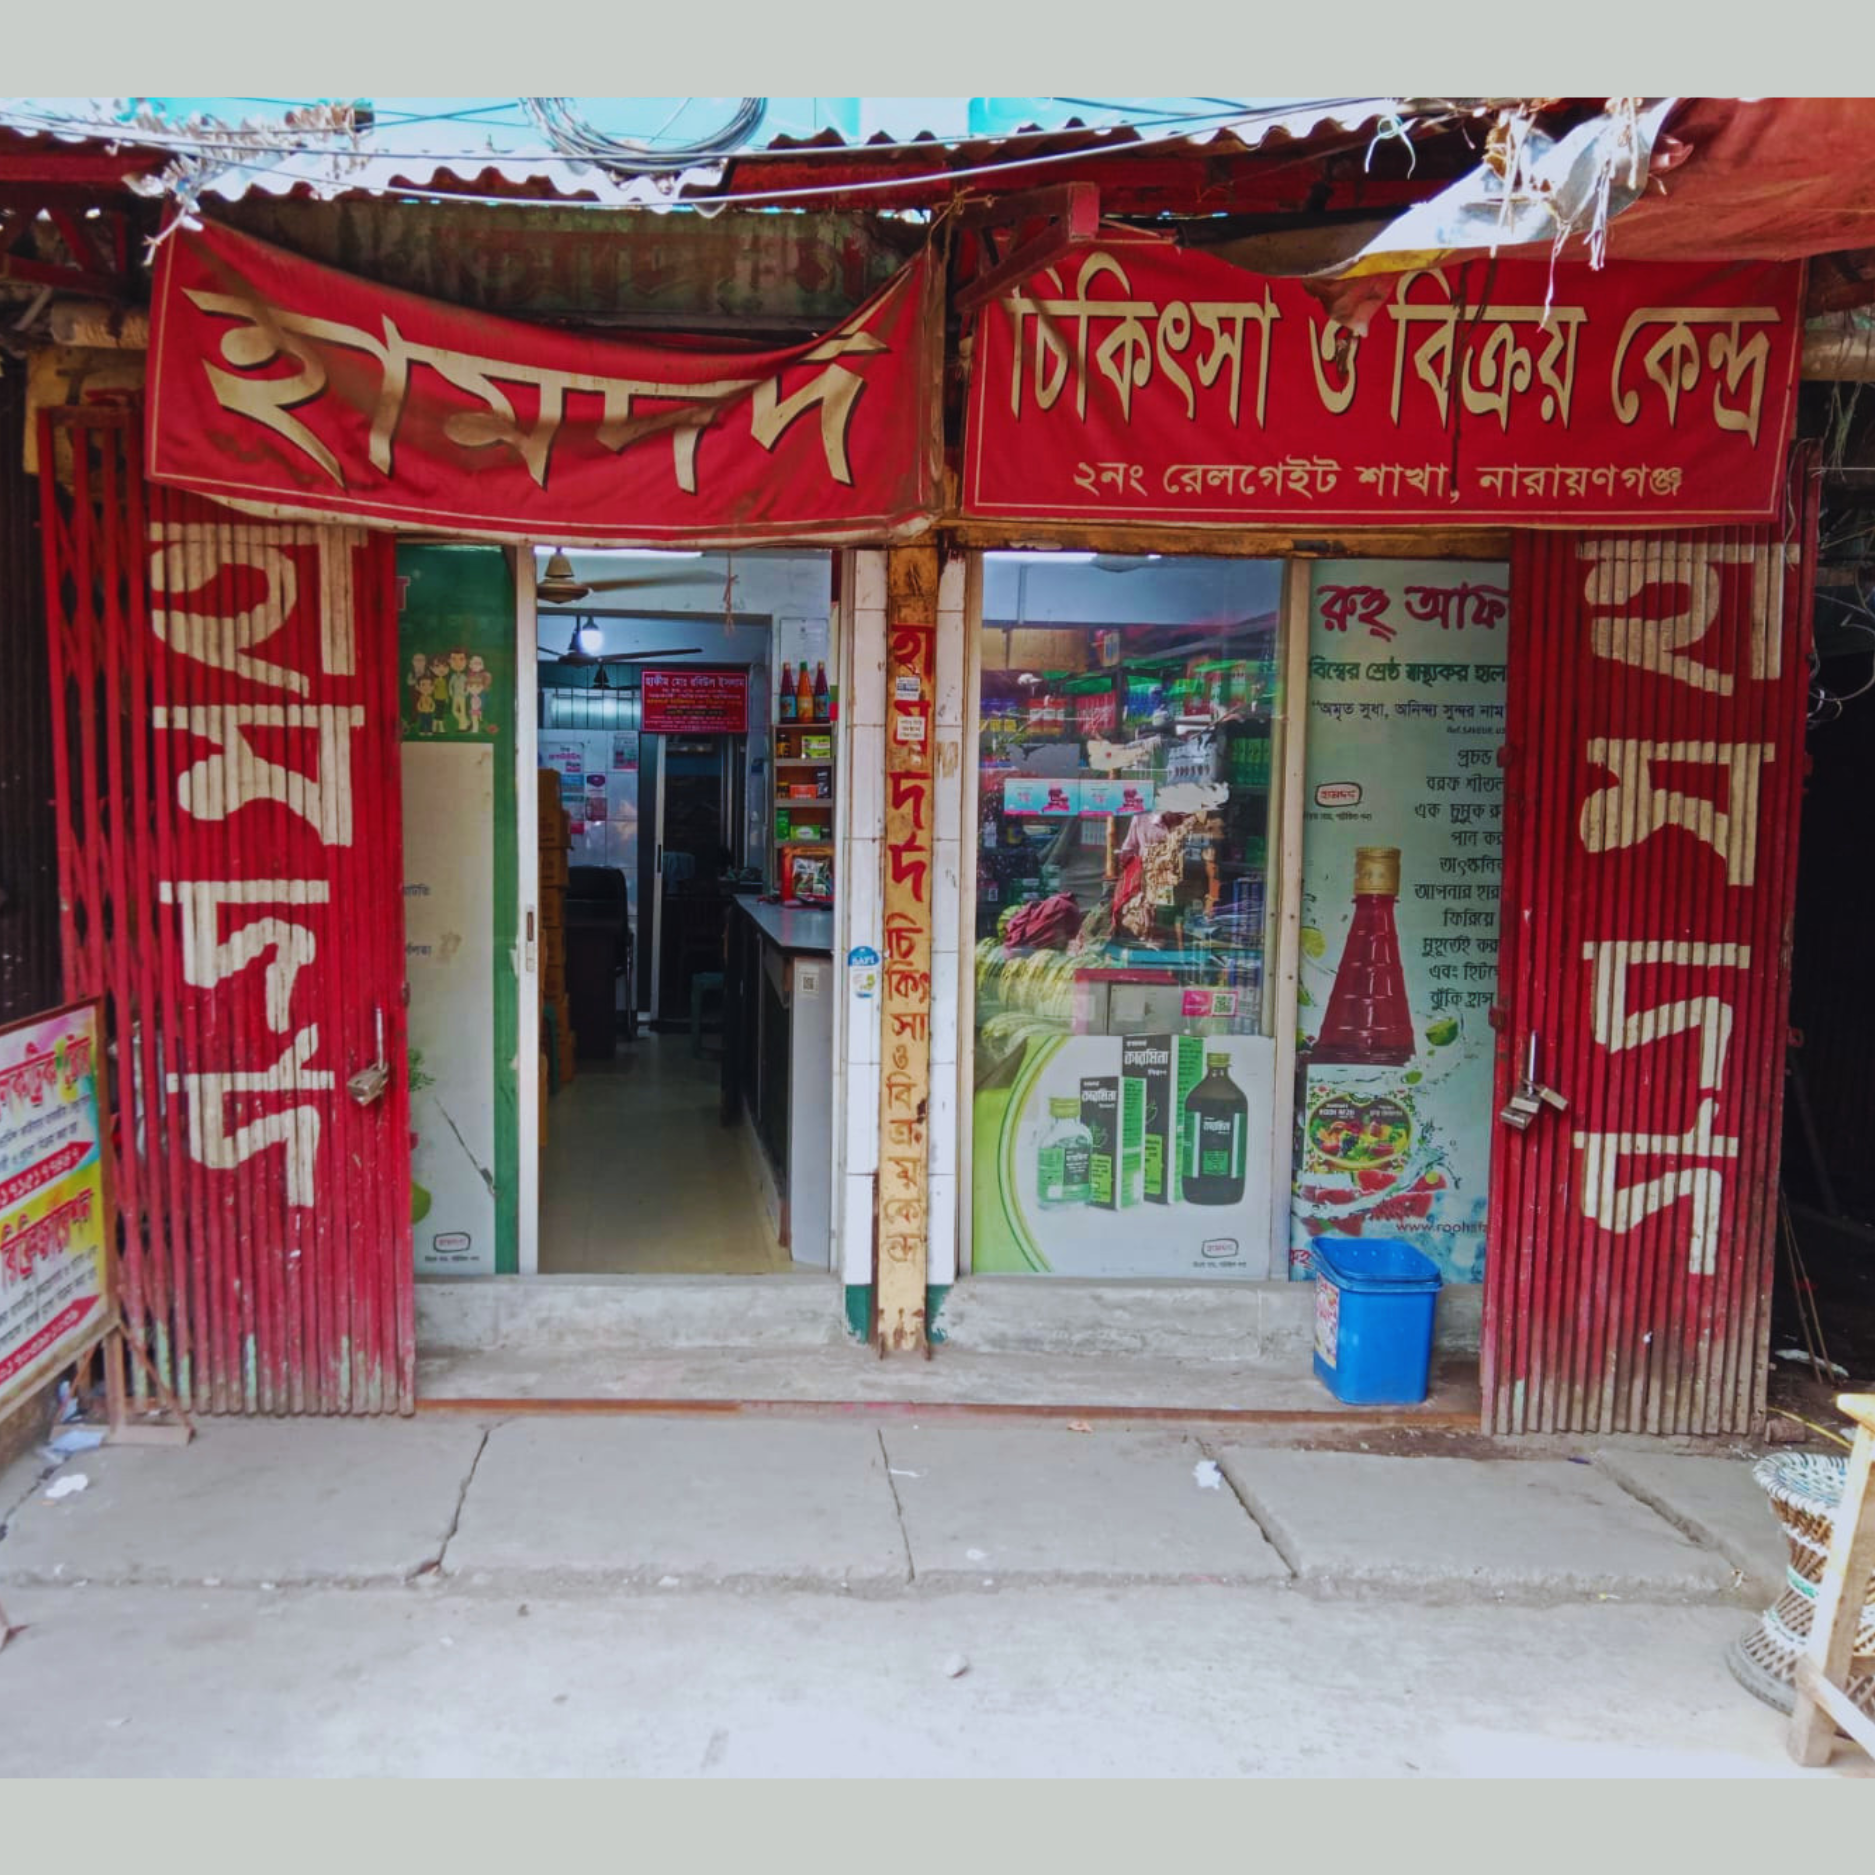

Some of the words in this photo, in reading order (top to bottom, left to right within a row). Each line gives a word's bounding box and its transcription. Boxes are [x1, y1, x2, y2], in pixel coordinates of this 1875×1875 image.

[1002, 251, 1281, 428] চিকিৎসা
[1389, 264, 1587, 432] বিক্রয়
[1612, 306, 1782, 446] কেন্দ্র
[182, 286, 890, 492] হামদর্দ
[1074, 461, 1145, 496] ২নং
[1163, 457, 1342, 497] রেলগেইট
[1355, 463, 1460, 503] শাখা,
[1478, 463, 1684, 499] নারায়ণগঞ্জ
[1426, 776, 1461, 791] বরফ
[1414, 803, 1441, 819] এক
[1450, 830, 1479, 846] পান
[1414, 883, 1472, 901] আপনার
[1442, 907, 1496, 927] ফিরিয়ে
[1428, 965, 1458, 981] এবং
